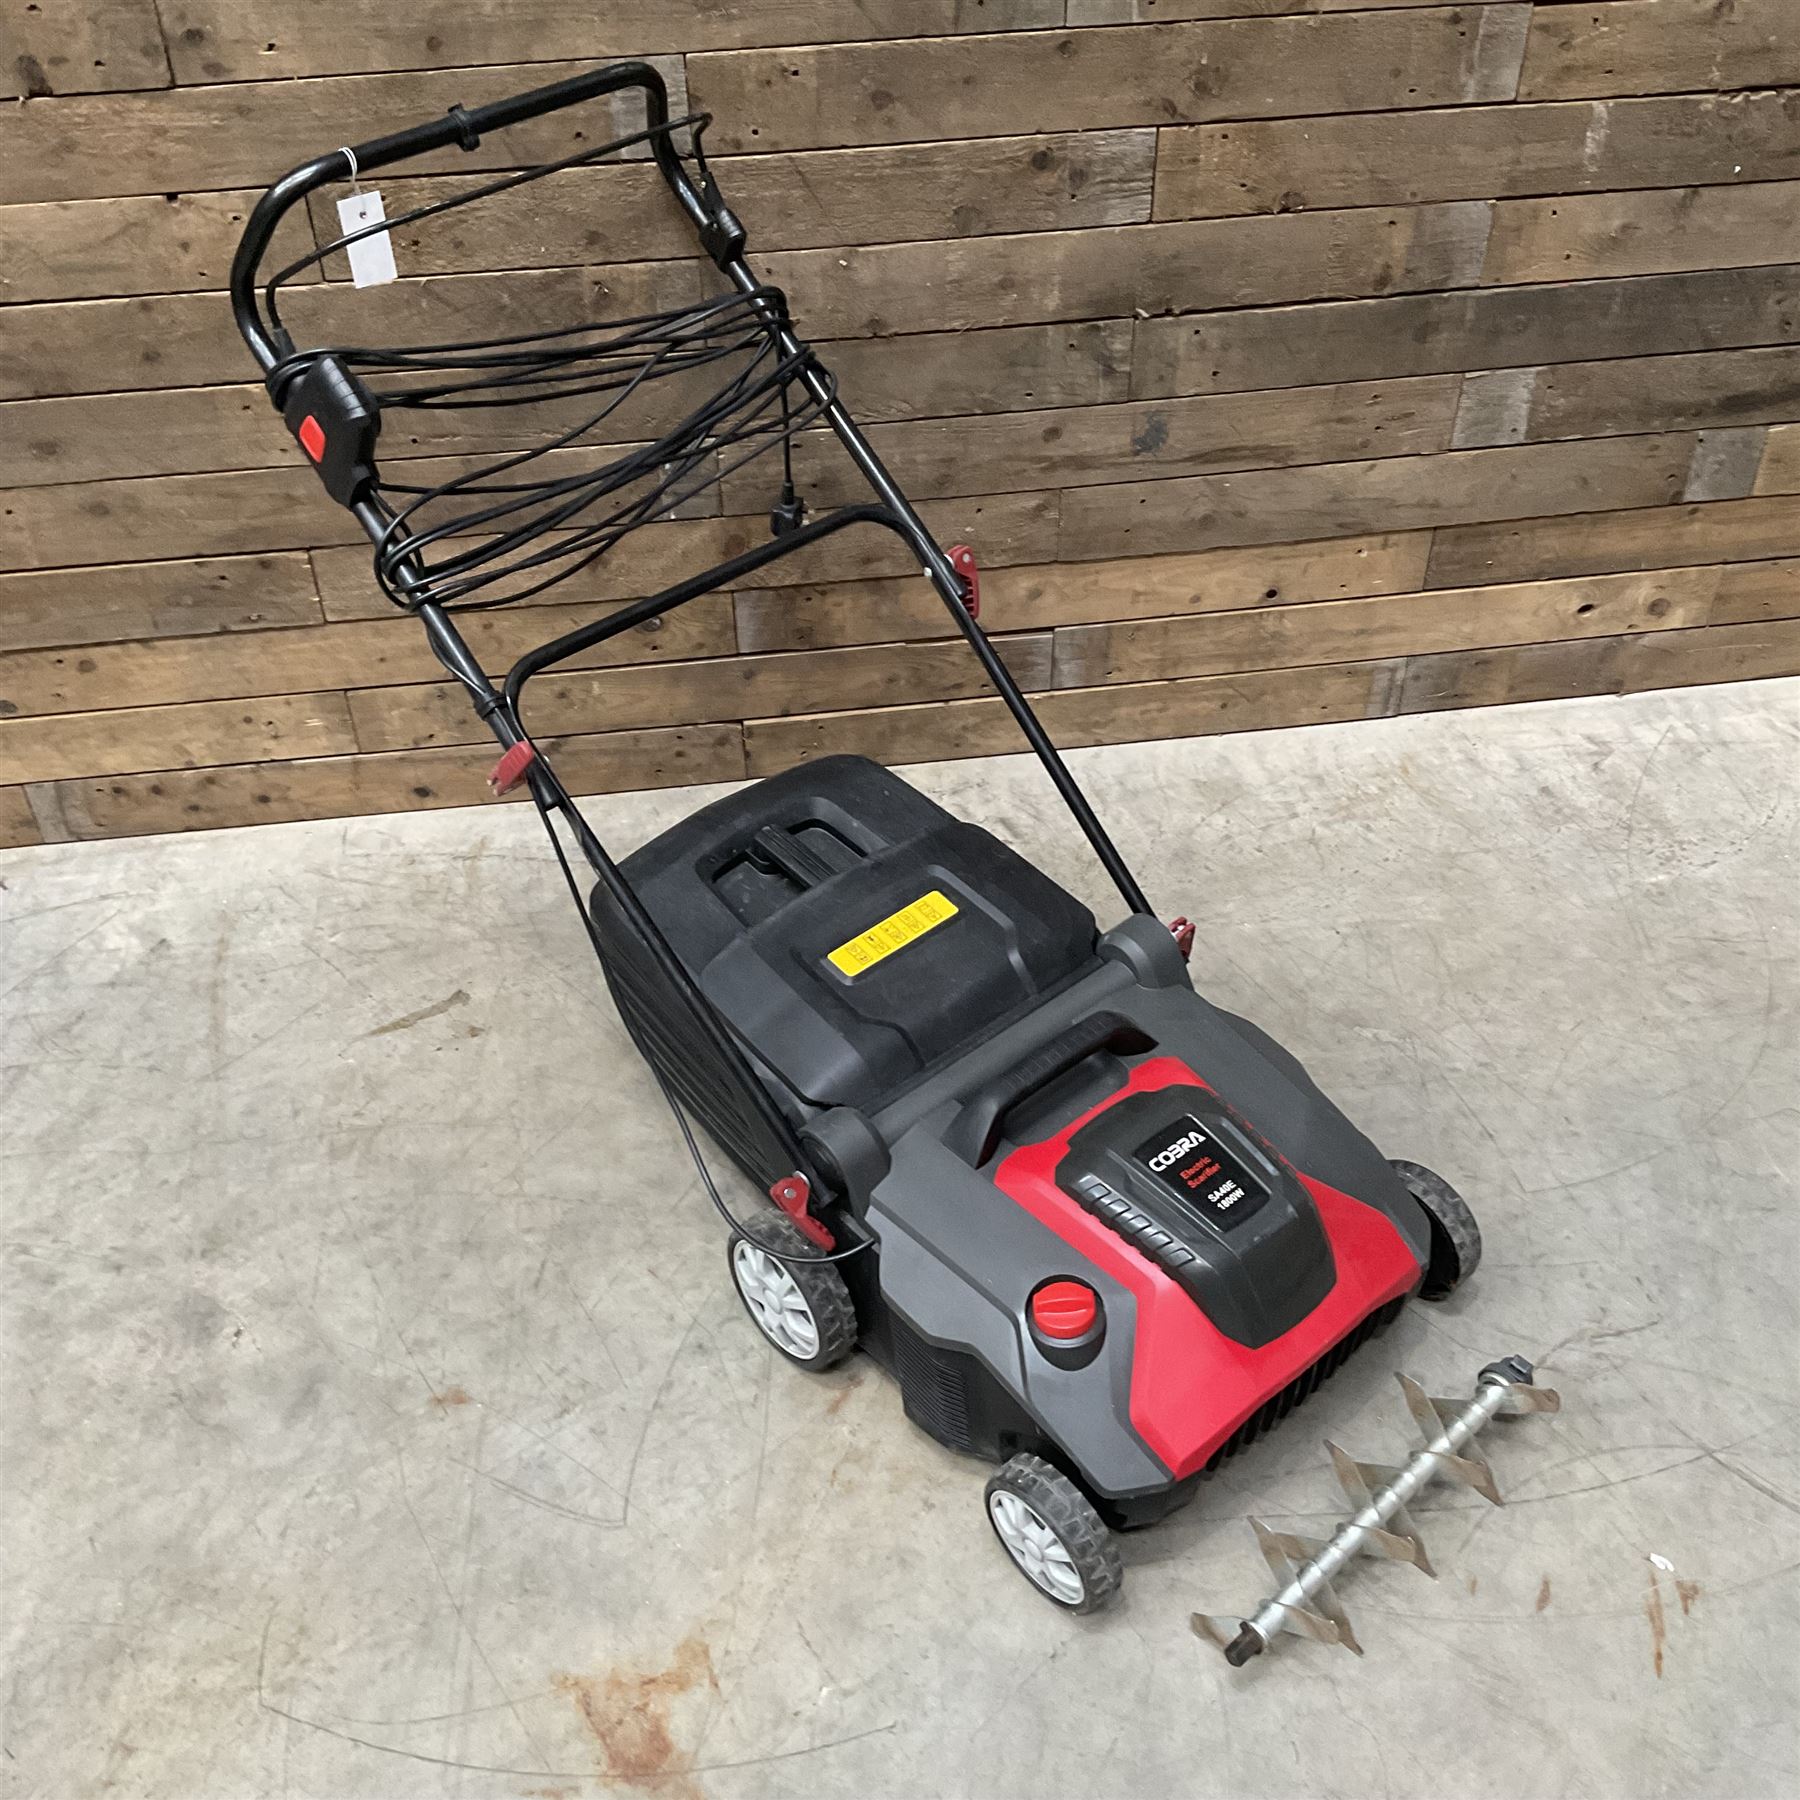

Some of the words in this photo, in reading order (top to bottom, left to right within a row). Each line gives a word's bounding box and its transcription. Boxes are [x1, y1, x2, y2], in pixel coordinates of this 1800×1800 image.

[1148, 1131, 1207, 1172] COBRA
[1179, 1156, 1212, 1180] Electric
[1187, 1163, 1221, 1188] Scarifier
[1207, 1180, 1237, 1203] SA40E
[1217, 1188, 1245, 1210] 1800W
